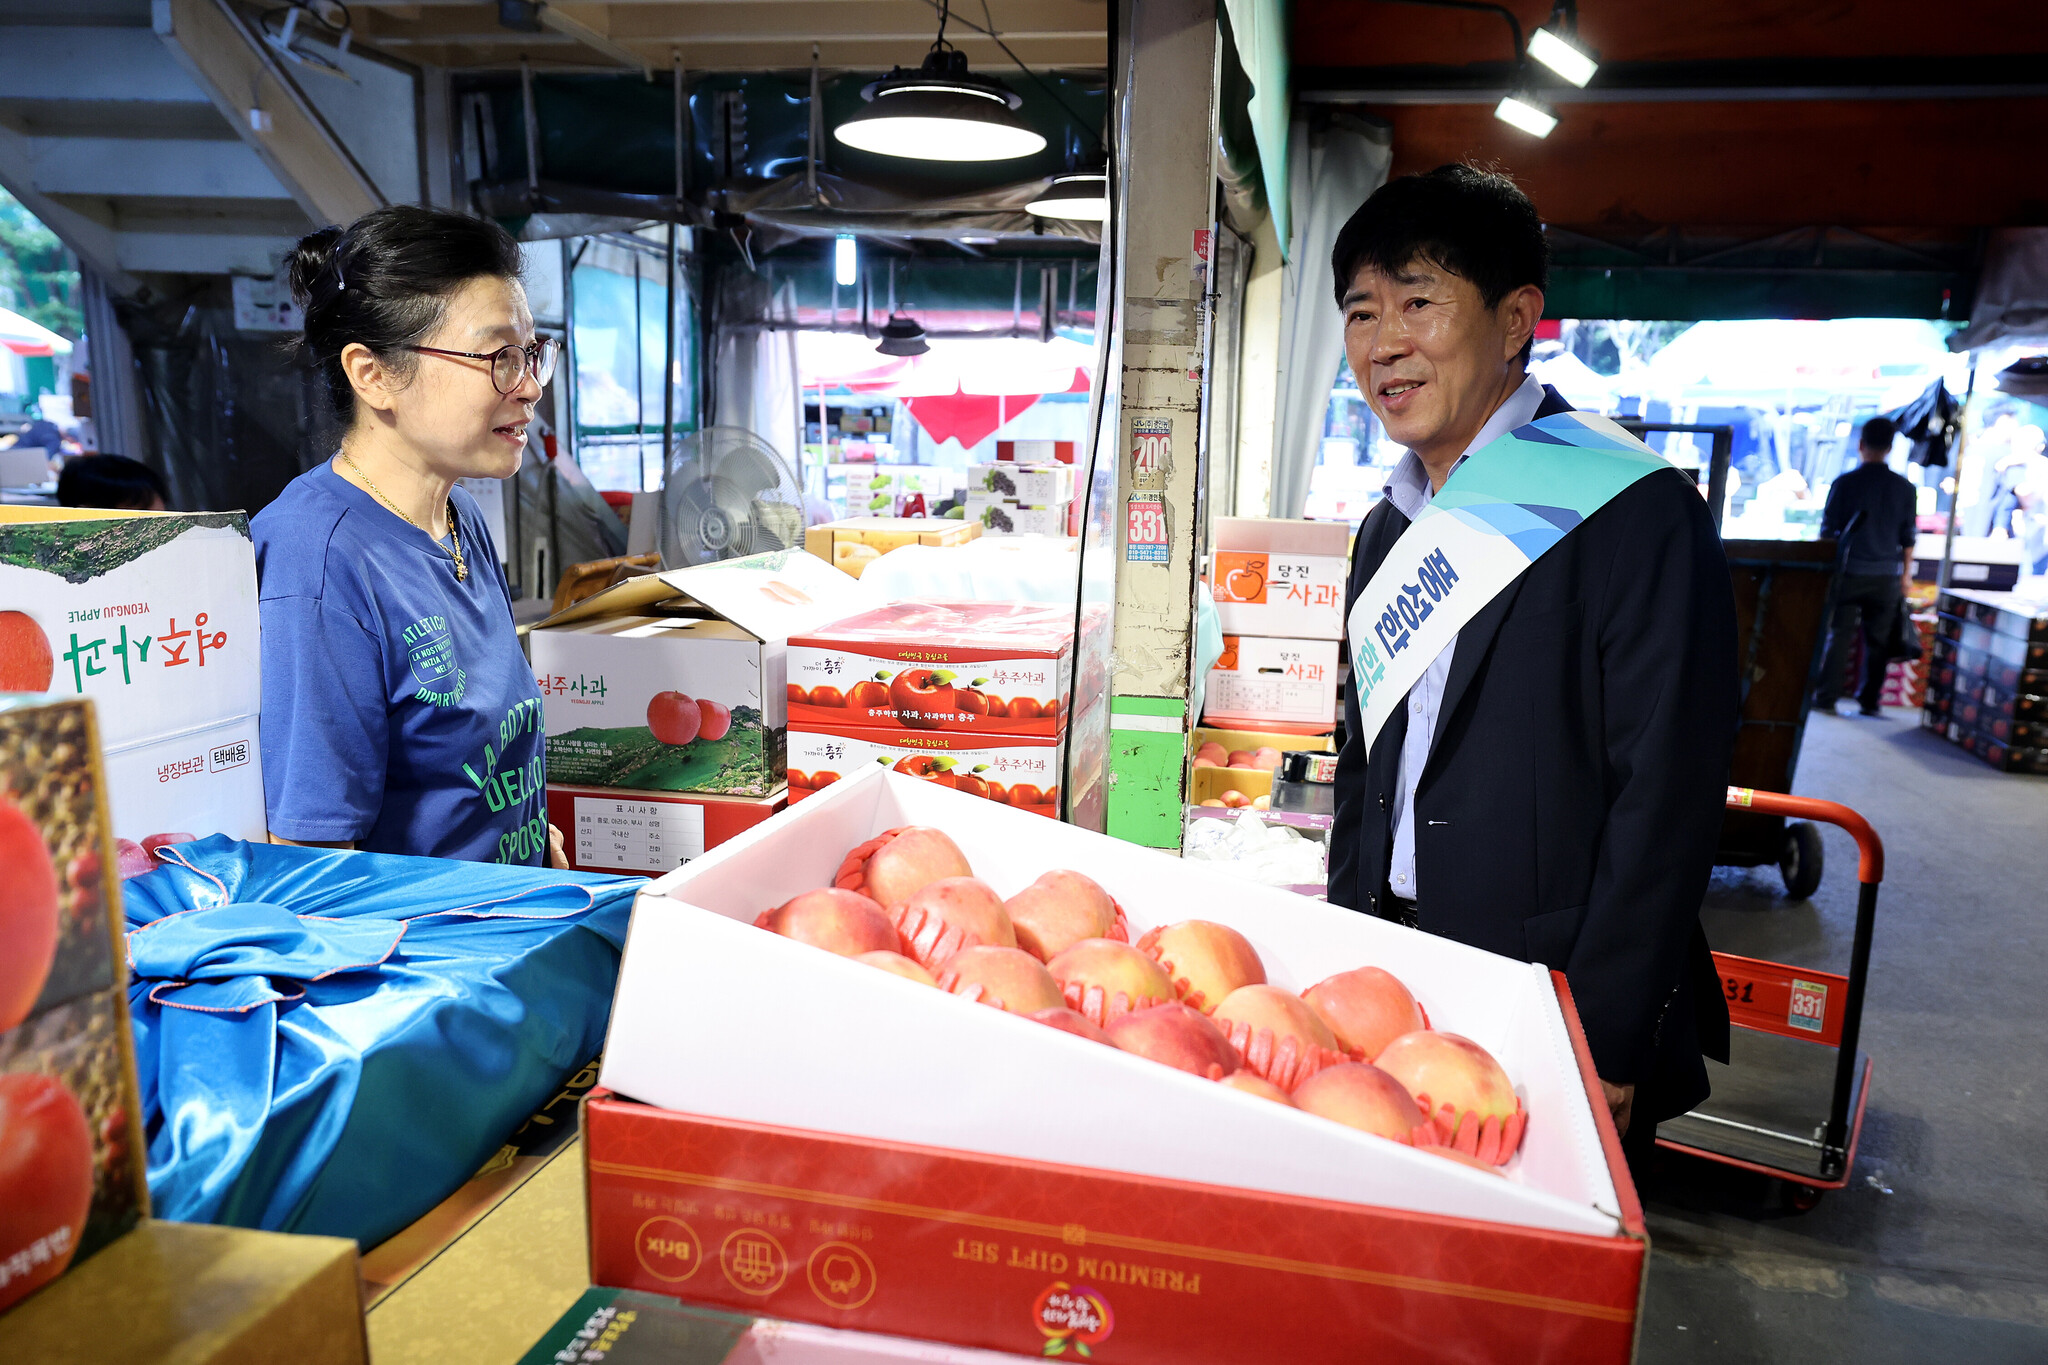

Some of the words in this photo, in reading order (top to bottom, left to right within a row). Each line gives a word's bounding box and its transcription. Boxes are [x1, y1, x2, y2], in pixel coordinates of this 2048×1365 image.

[1130, 510, 1167, 542] 331
[1287, 584, 1339, 607] 사과
[1374, 547, 1459, 660] 풍성한
[68, 608, 100, 623] APPLE
[103, 602, 150, 619] YEONGJU
[420, 656, 441, 669] INIZIA
[824, 657, 842, 675] 충주
[1286, 664, 1324, 681] 사과
[998, 670, 1046, 685] 충주사과
[868, 708, 899, 718] 충주하면
[902, 710, 922, 720] 사과,
[924, 712, 955, 722] 사과하면
[958, 713, 976, 723] 충주
[825, 743, 843, 760] 충주
[157, 755, 205, 783] 냉장보관
[214, 743, 247, 766] 택배용
[462, 743, 497, 790] LA
[999, 758, 1046, 772] 충주사과
[485, 756, 544, 813] DELLO
[611, 830, 630, 839] 국내산
[614, 843, 627, 851] 5kg
[1793, 993, 1822, 1018] 331
[647, 1236, 690, 1261] Brix
[952, 1238, 999, 1264] SET
[1007, 1247, 1069, 1274] GIFT
[1077, 1256, 1201, 1295] PREMIUM
